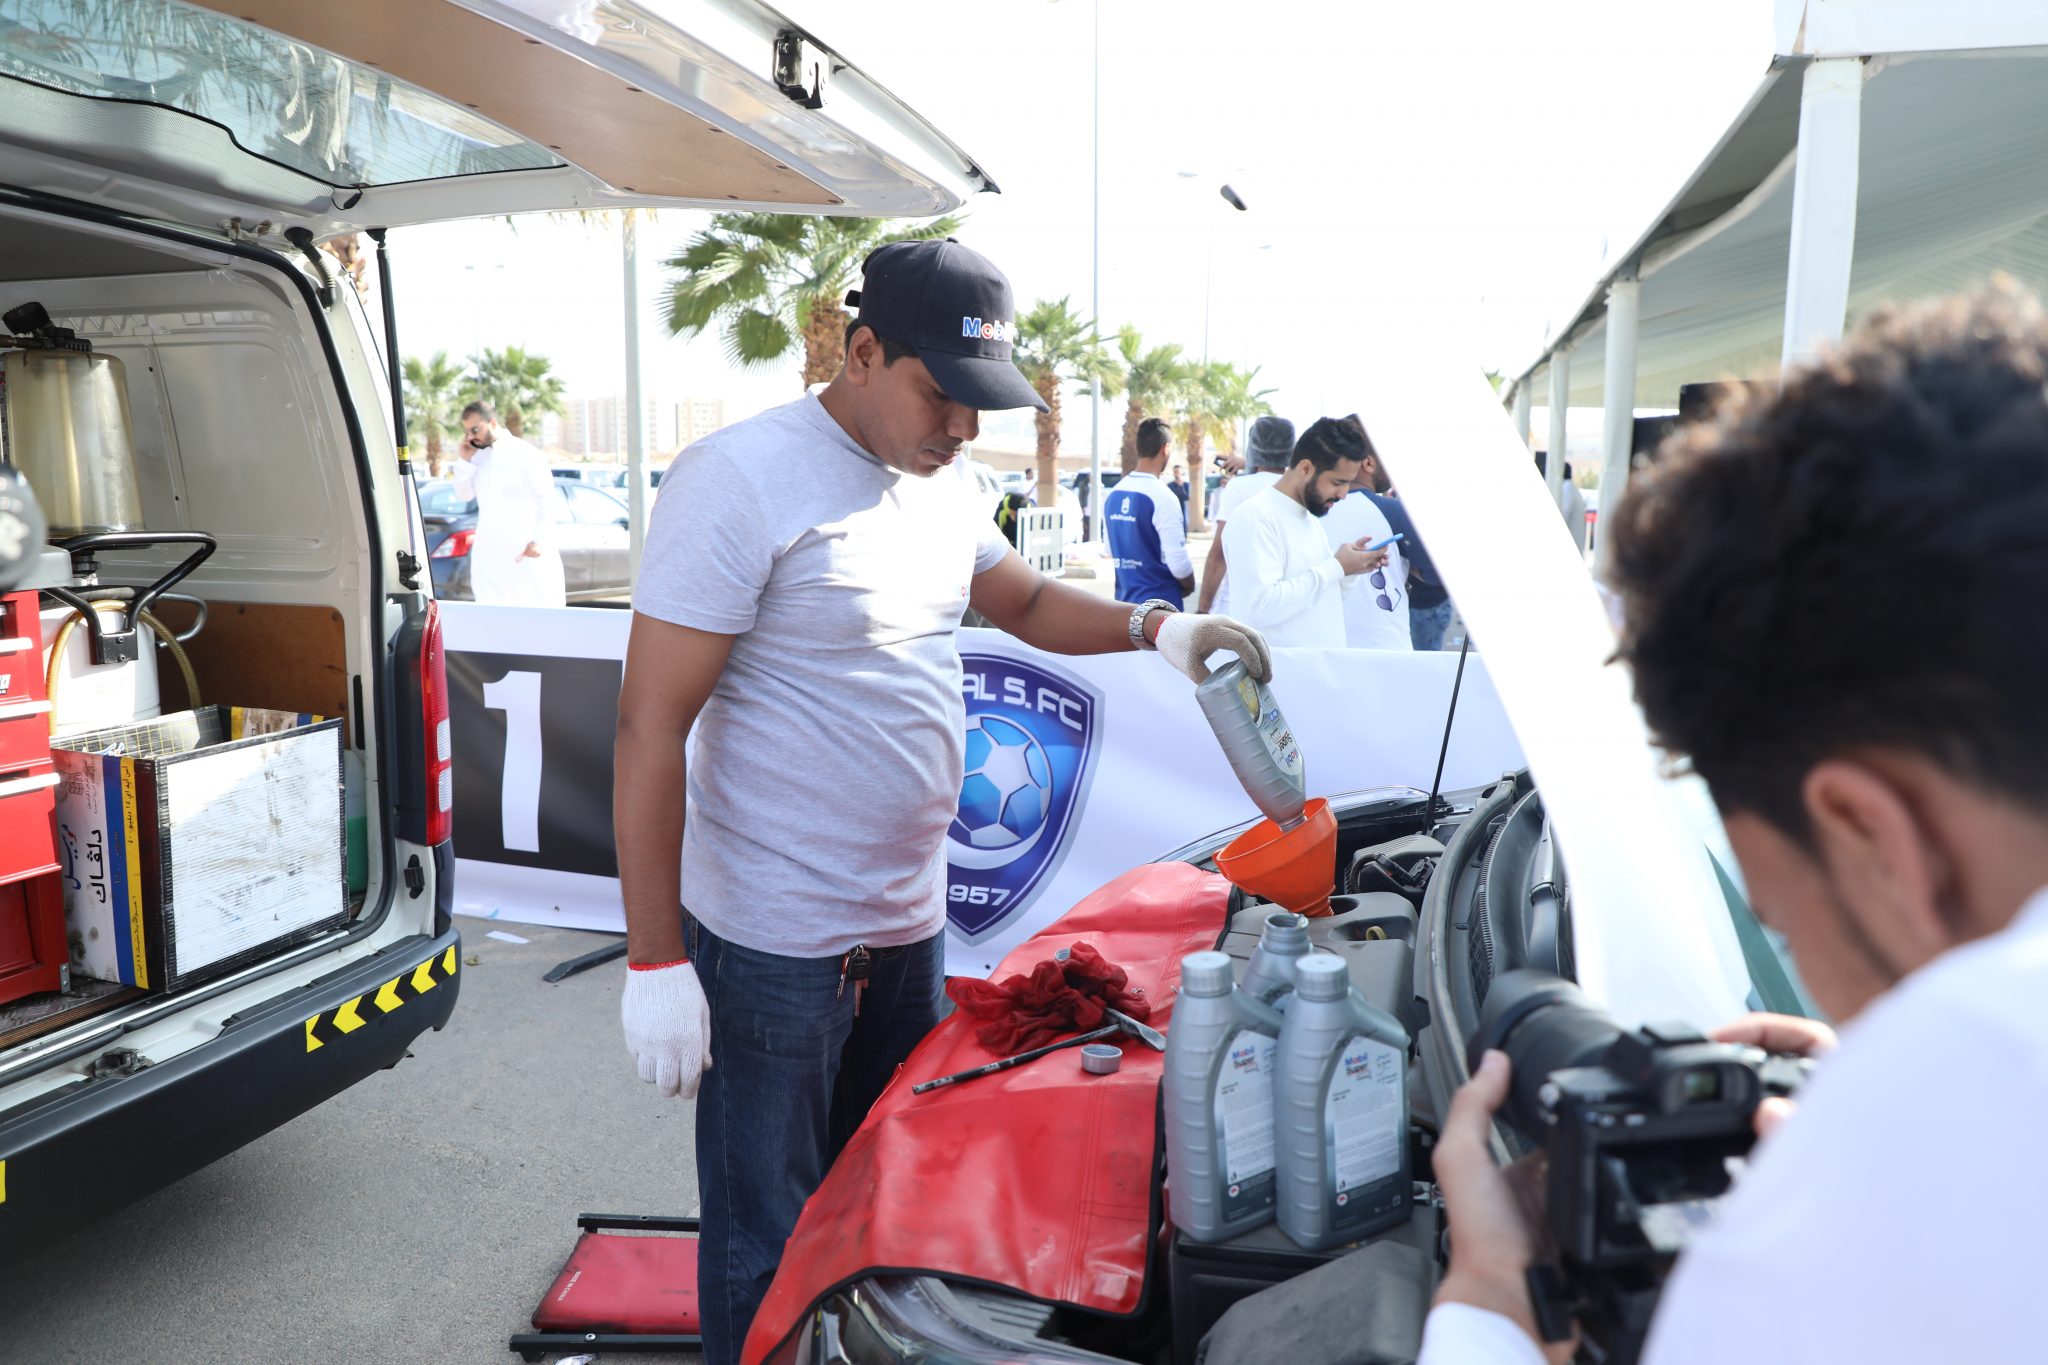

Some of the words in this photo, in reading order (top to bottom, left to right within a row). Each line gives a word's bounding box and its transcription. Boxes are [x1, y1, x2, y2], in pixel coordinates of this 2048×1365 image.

[962, 673, 997, 701] AL
[483, 670, 543, 853] 1
[947, 884, 1011, 906] 957
[1345, 1053, 1368, 1066] Mobil
